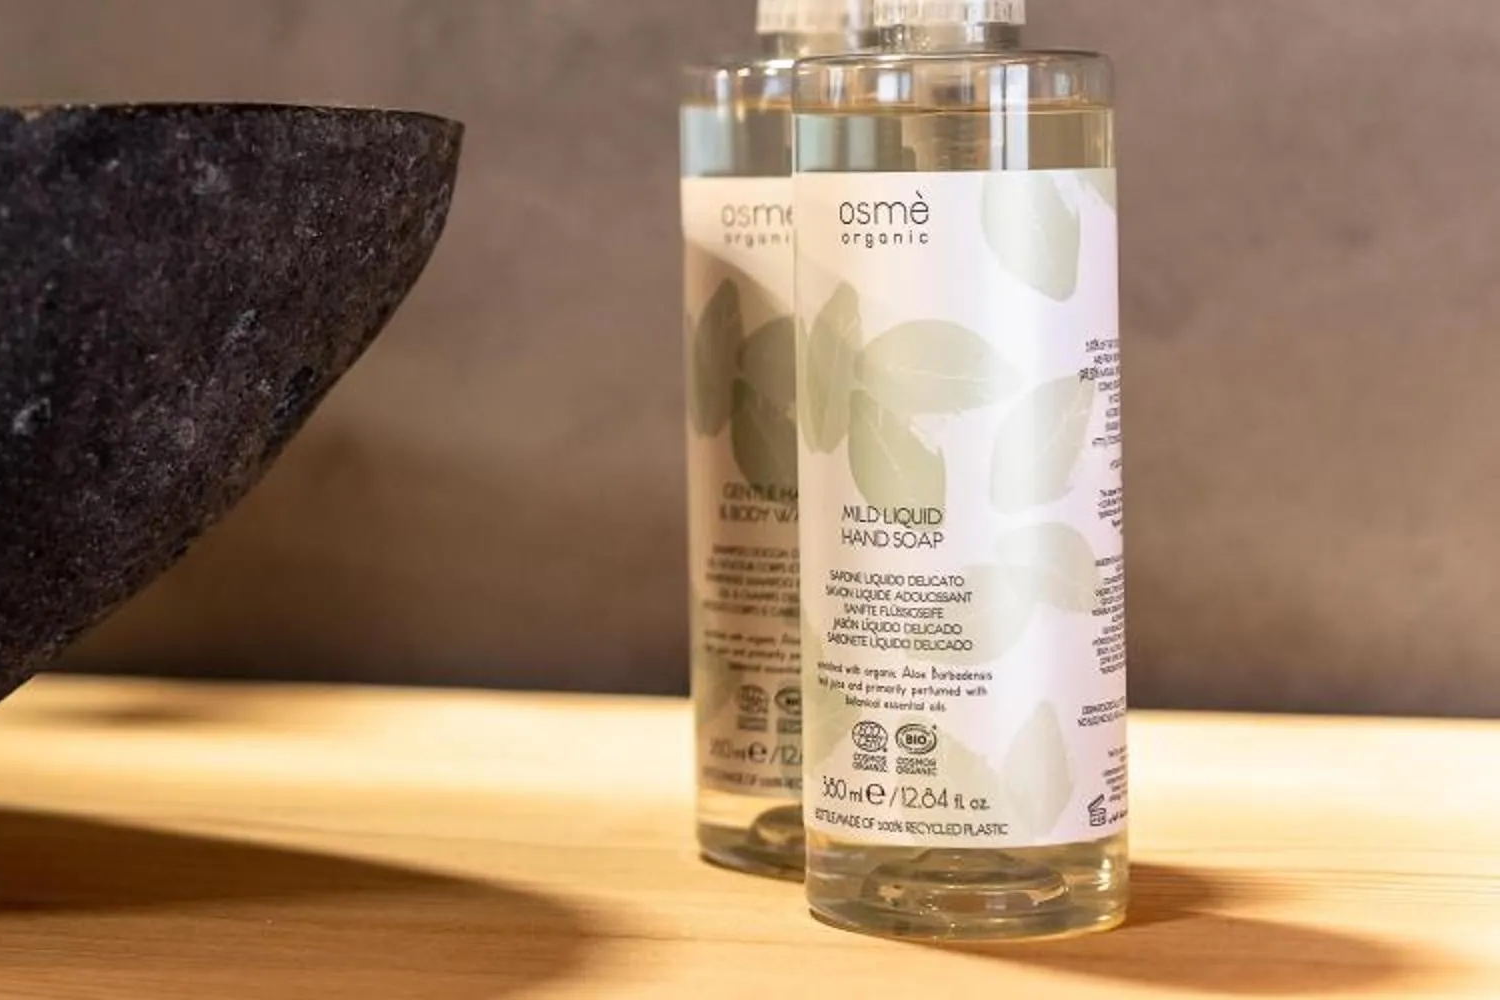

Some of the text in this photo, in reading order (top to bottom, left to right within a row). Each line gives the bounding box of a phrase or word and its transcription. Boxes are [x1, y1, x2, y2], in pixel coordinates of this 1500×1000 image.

[839, 190, 929, 225] osmè
[724, 231, 790, 247] organi
[841, 230, 929, 248] organic
[841, 504, 943, 528] MILD LIQUID
[841, 529, 944, 549] HAND SOAP
[864, 573, 905, 587] LIQUIDO
[908, 575, 965, 587] DELICATO
[855, 588, 891, 602] LIQUIDE
[861, 617, 900, 636] LÍQUIDO
[903, 623, 963, 635] DELICADO
[914, 639, 973, 651] DELICADO
[864, 668, 897, 681] organic
[902, 665, 927, 679] Aloe
[865, 684, 906, 697] primarily
[911, 685, 961, 698] perfumed
[965, 686, 987, 697] with
[883, 699, 924, 711] essential
[905, 733, 927, 745] BIO
[862, 817, 875, 830] OF
[905, 821, 962, 835] RECYCLED
[963, 823, 1009, 837] PLASTIC
